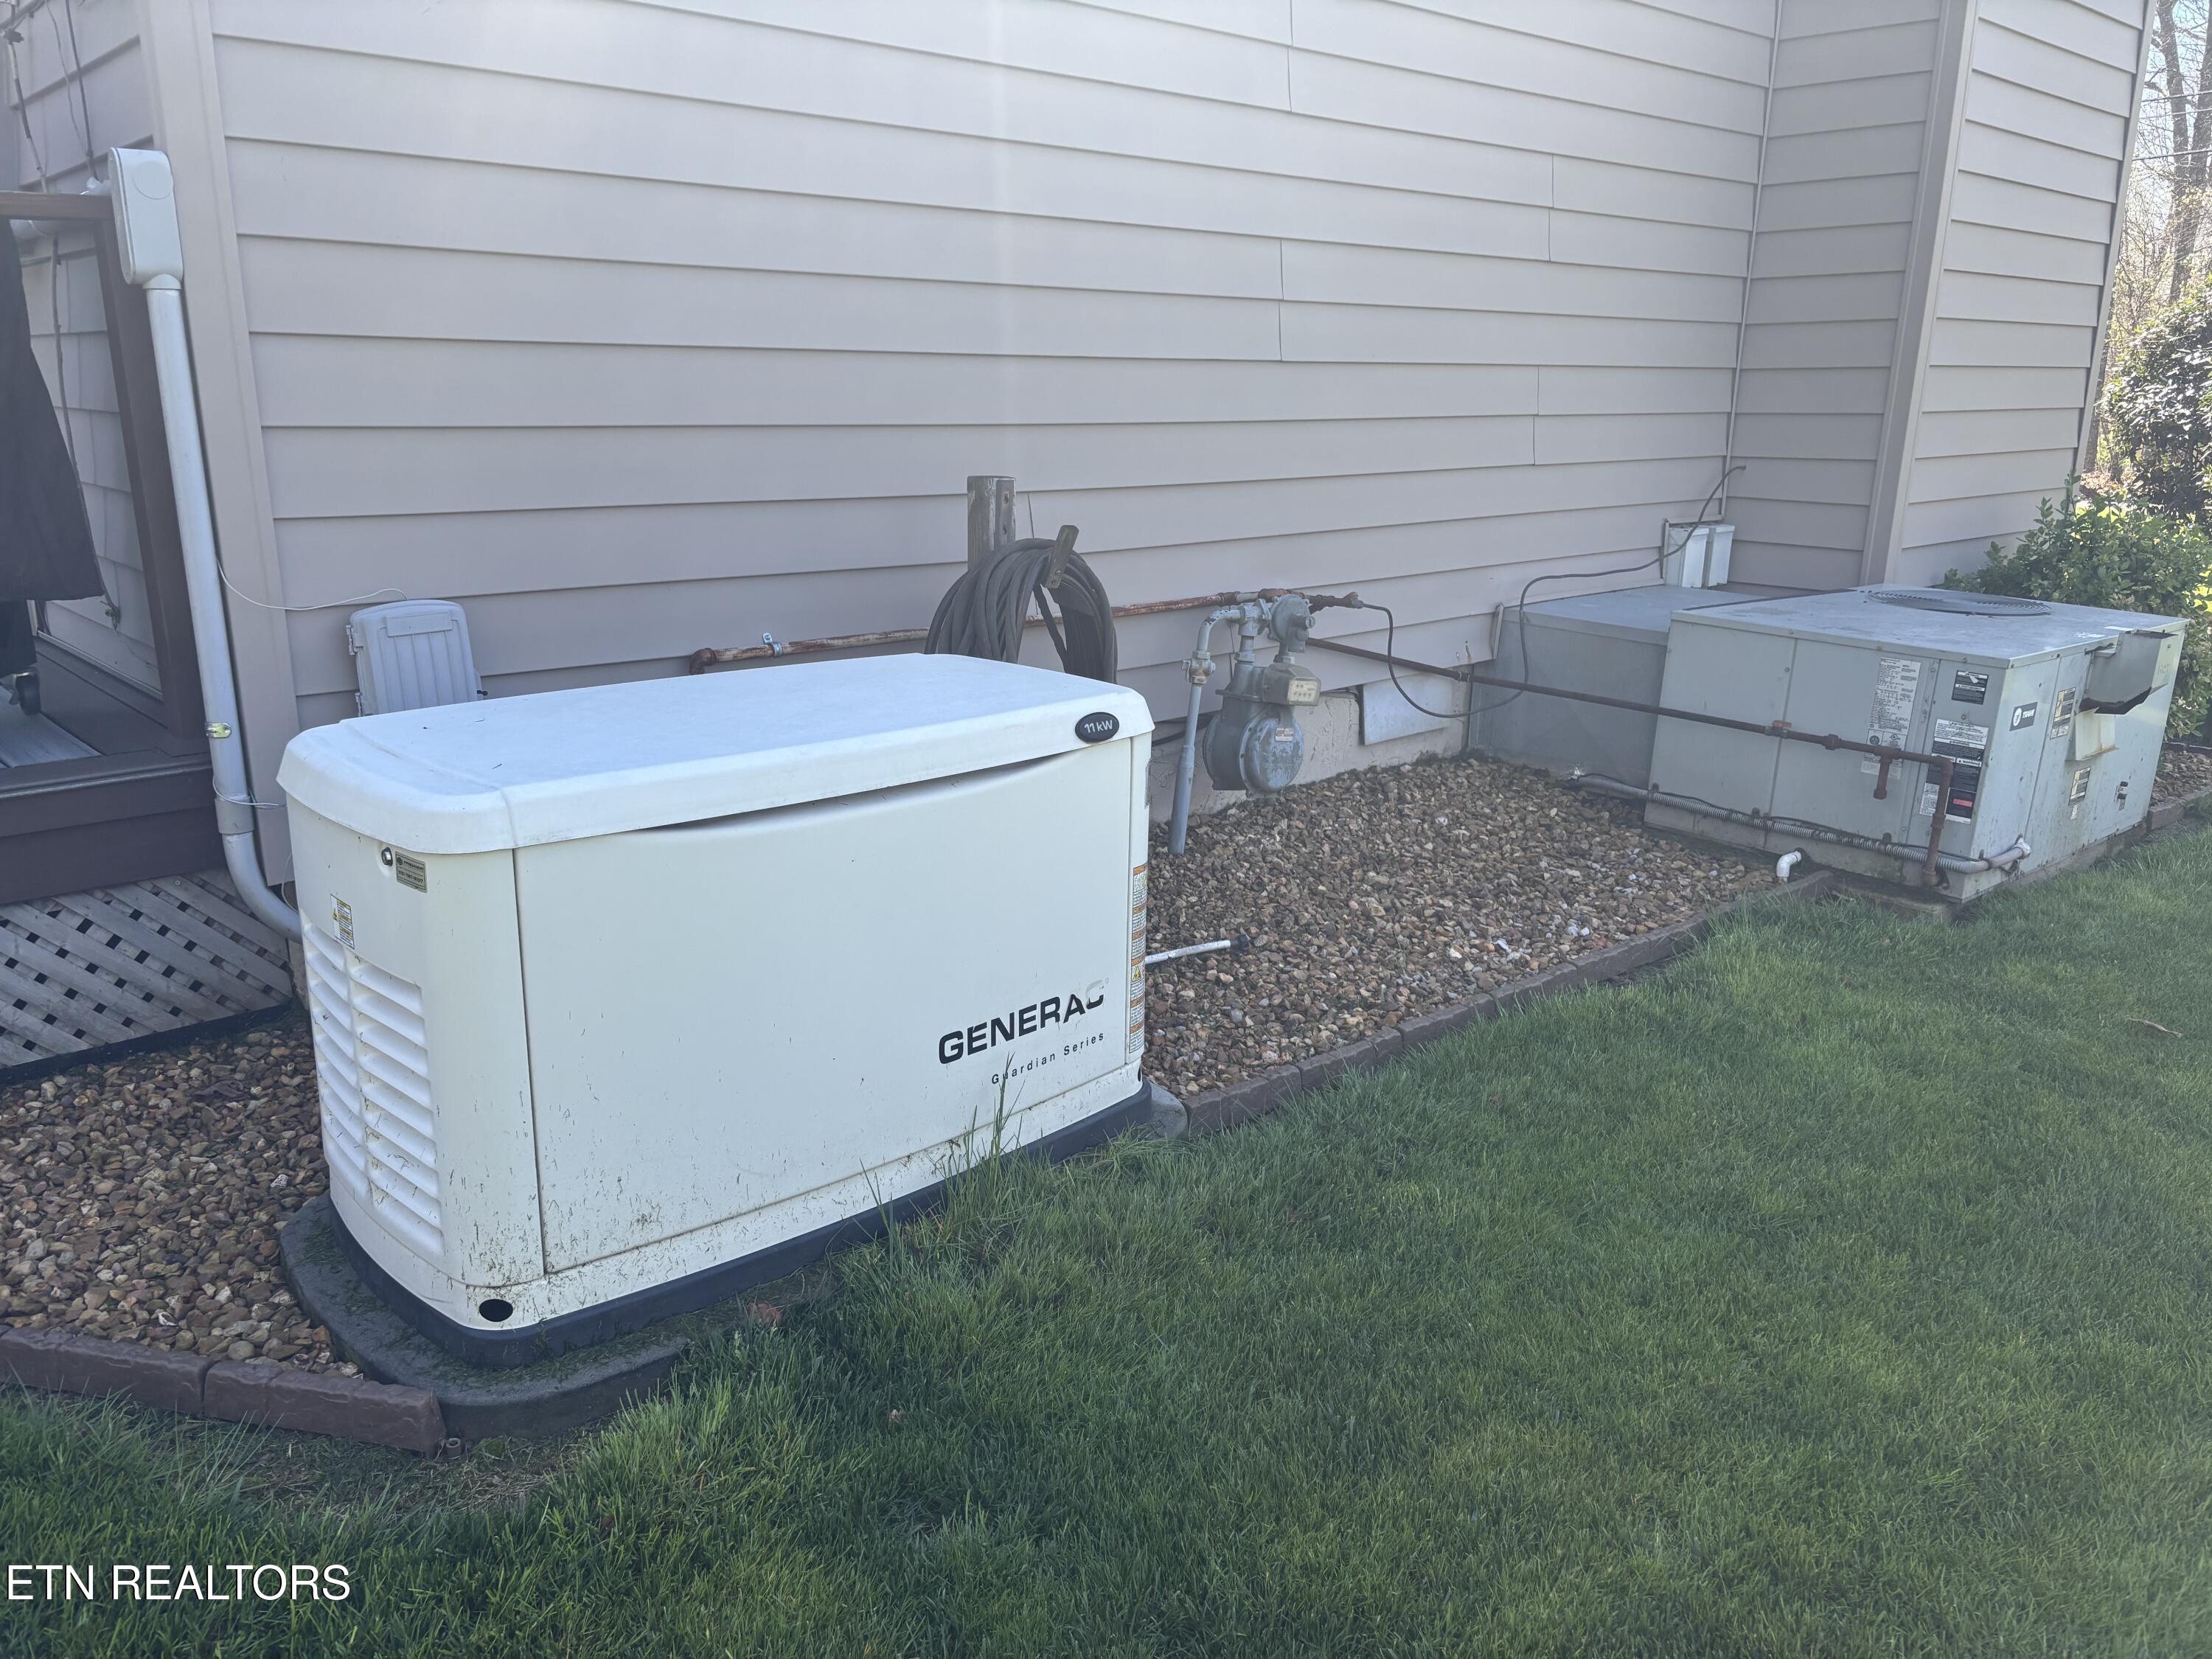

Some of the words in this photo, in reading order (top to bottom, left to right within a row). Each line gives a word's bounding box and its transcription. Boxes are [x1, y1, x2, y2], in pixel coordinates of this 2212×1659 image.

[2022, 709, 2036, 719] TRANE
[939, 981, 1105, 1065] GENERAC
[991, 1053, 1056, 1085] Guardian
[1063, 1032, 1105, 1056] Series
